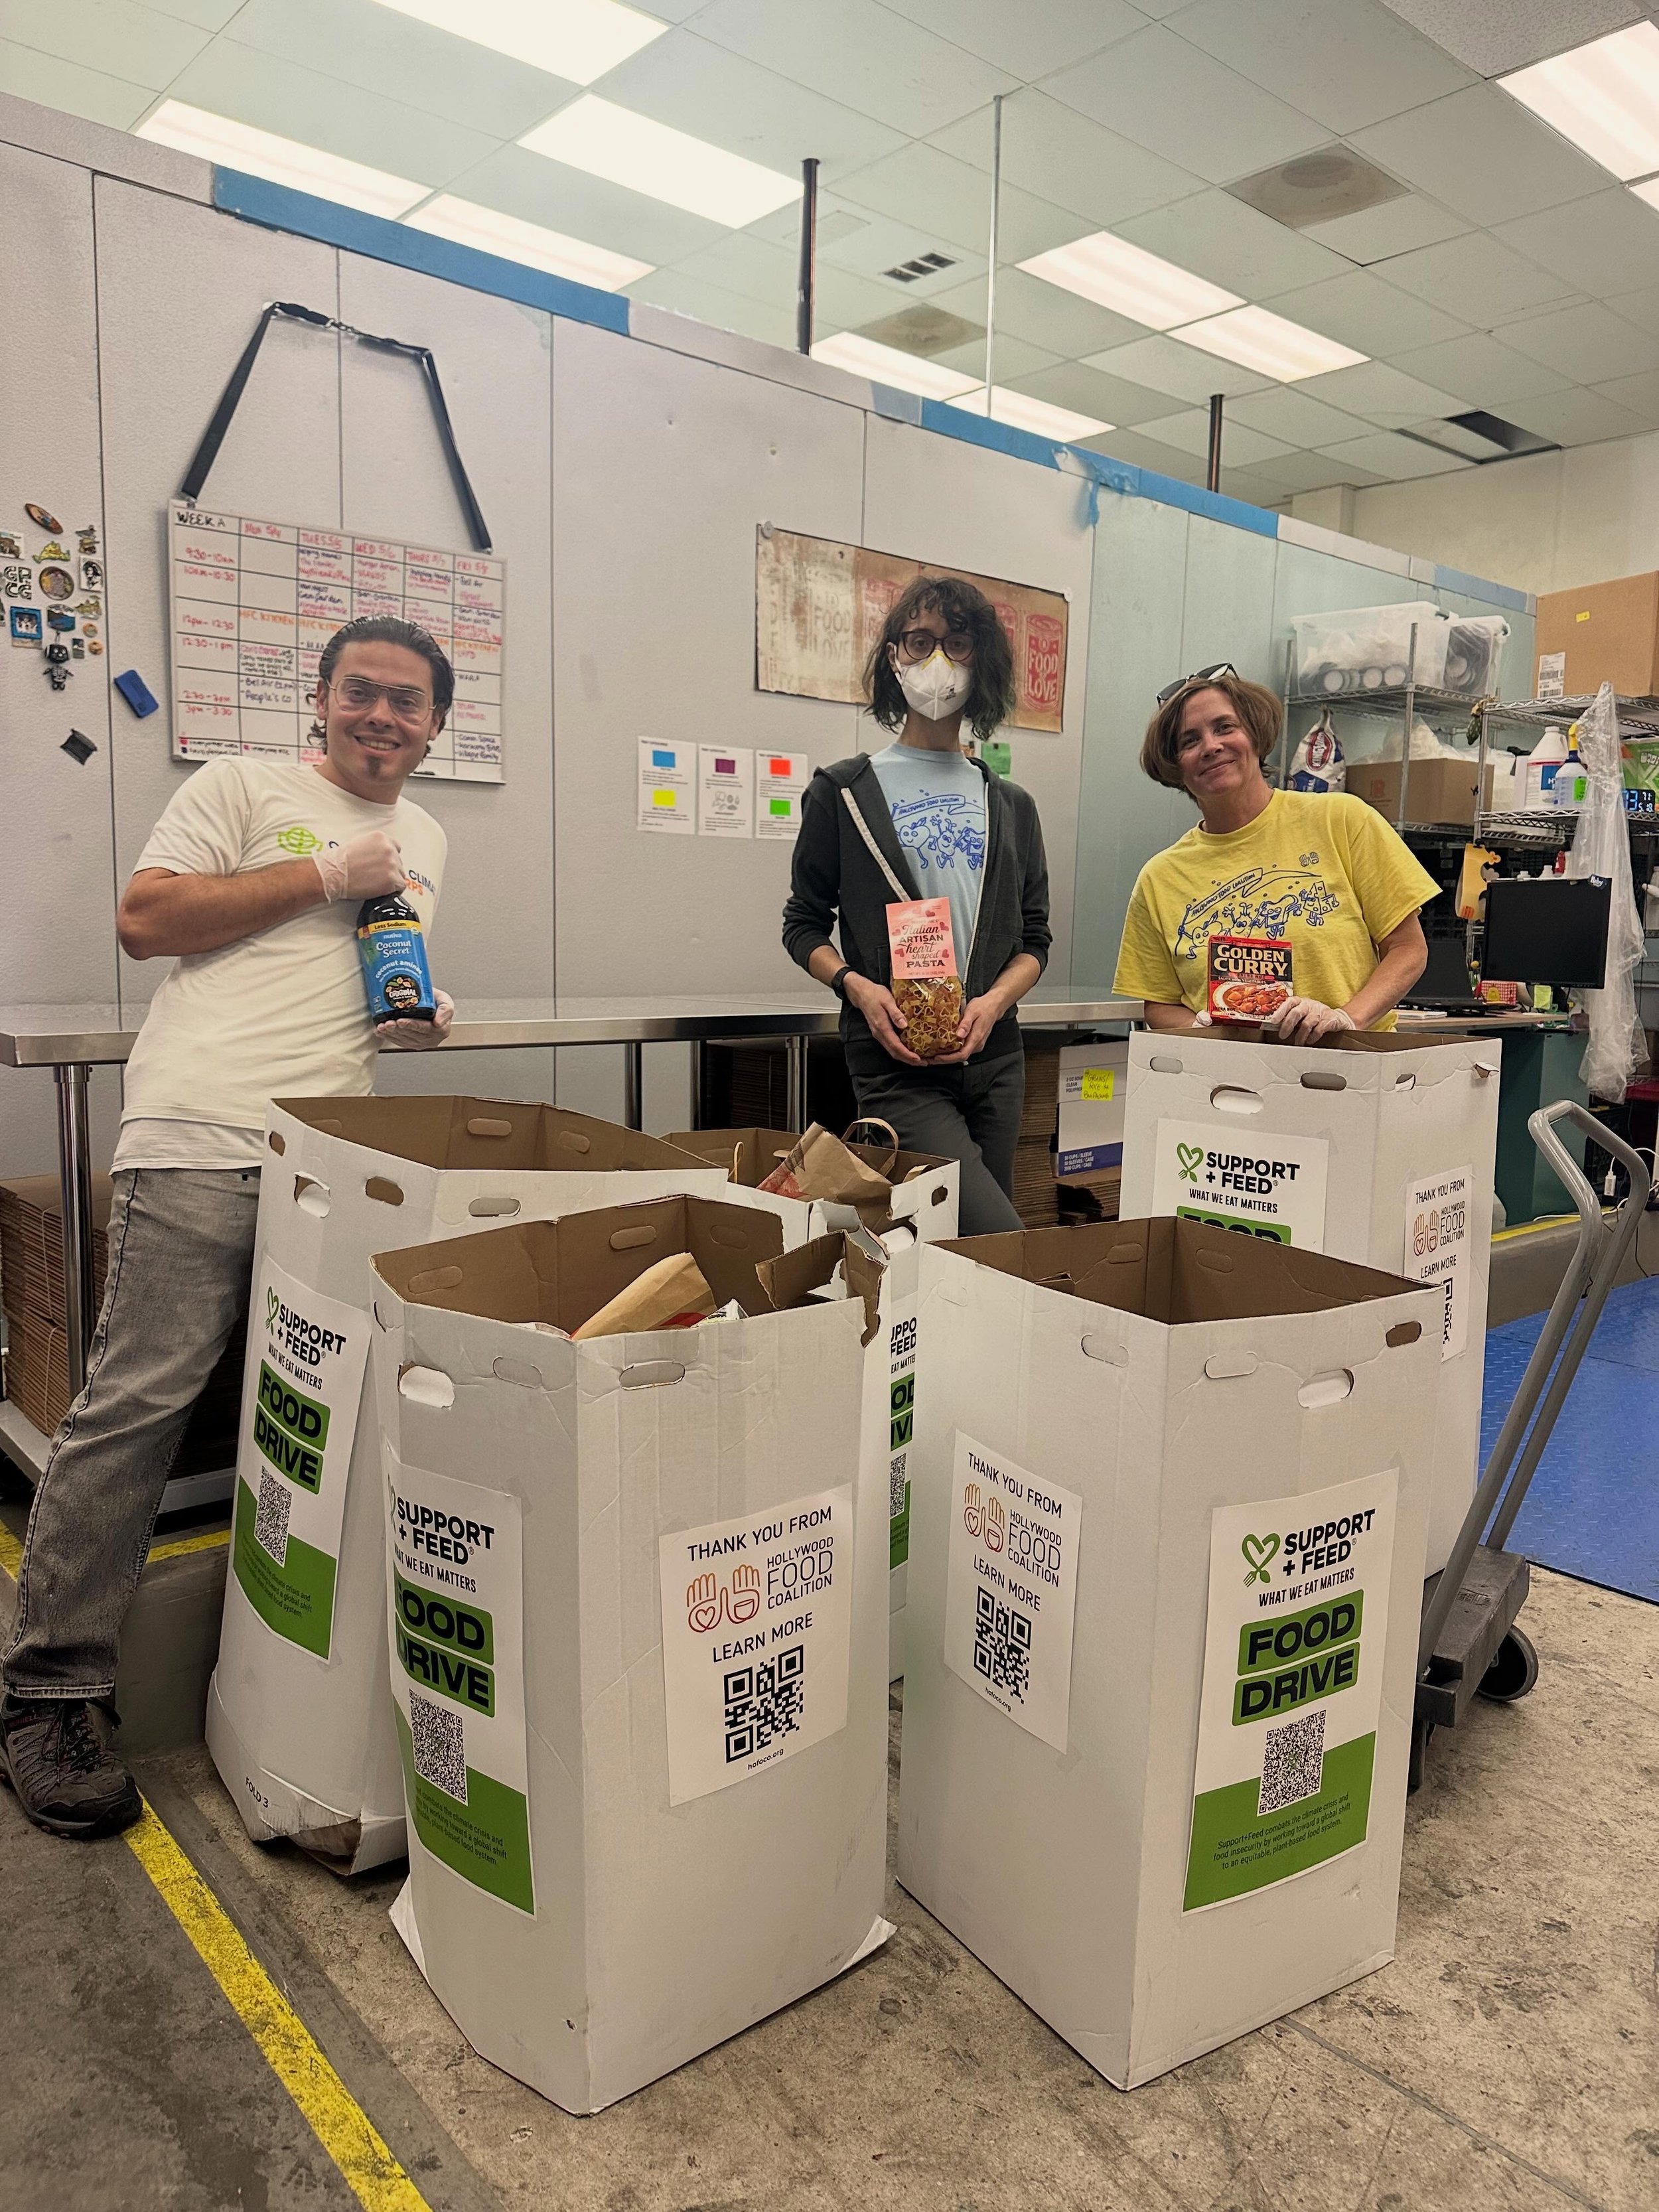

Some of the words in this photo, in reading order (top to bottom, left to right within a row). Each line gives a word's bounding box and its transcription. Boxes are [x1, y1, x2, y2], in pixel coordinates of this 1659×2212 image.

[177, 512, 215, 527] WEEK
[217, 518, 226, 528] A
[1029, 648, 1058, 674] FOOD
[1029, 674, 1057, 701] LOVE
[900, 934, 944, 943] ARTISAN
[902, 924, 940, 936] Italian
[376, 940, 412, 951] Coconut
[383, 947, 410, 958] Secret
[897, 942, 937, 954] heart
[912, 950, 941, 962] shaped
[1217, 944, 1285, 962] GOLDEN
[376, 960, 398, 979] coconut
[906, 960, 946, 968] PASTA
[1214, 957, 1289, 976] CURRY
[389, 988, 418, 998] ORIGINAL
[1206, 1151, 1300, 1180] SUPPORT
[1206, 1171, 1216, 1183] +
[1189, 1188, 1210, 1201] WHAT
[1212, 1193, 1223, 1204] WE
[1225, 1195, 1239, 1207] EAT
[1241, 1199, 1278, 1213] MATTERS
[1415, 1188, 1436, 1205] THANK
[1437, 1185, 1449, 1198] YOU
[1449, 1179, 1465, 1194] FROM
[1441, 1201, 1465, 1216] HOLLYWOOD
[1440, 1211, 1465, 1236] FOOD
[1440, 1230, 1465, 1247] COALITION
[1421, 1262, 1439, 1280] LEARN
[1441, 1254, 1457, 1272] MORE
[279, 1303, 346, 1355] SUPPORT
[278, 1351, 285, 1367] WE
[285, 1358, 294, 1374] EAT
[294, 1365, 323, 1390] MATTERS
[891, 1362, 900, 1374] EAT
[901, 1353, 916, 1369] MATTE
[261, 1370, 322, 1439] FOOD
[256, 1408, 319, 1487] DRIVE
[968, 1451, 999, 1485] THANK
[1002, 1473, 1023, 1498] YOU
[1027, 1488, 1062, 1519] FROM
[397, 1497, 494, 1550] SUPPORT
[687, 1532, 747, 1561] THANK
[752, 1521, 783, 1545] YOU
[789, 1505, 831, 1533] FROM
[1010, 1509, 1062, 1546] HOLLYWOOD
[1283, 1508, 1376, 1556] SUPPORT
[767, 1536, 833, 1569] HOLLYWOOD
[1009, 1522, 1061, 1571] FOOD
[405, 1554, 417, 1572] WE
[419, 1561, 435, 1578] EAT
[437, 1566, 476, 1593] MATTERS
[768, 1550, 833, 1595] FOOD
[1008, 1548, 1059, 1588] COALITION
[1283, 1559, 1295, 1577] +
[768, 1573, 832, 1609] COALITION
[974, 1554, 1005, 1589] LEARN
[1009, 1578, 1041, 1613] MORE
[1259, 1589, 1287, 1607] WHAT
[1289, 1584, 1303, 1601] WE
[1304, 1579, 1319, 1597] EAT
[1320, 1567, 1355, 1595] MATTERS
[301, 1592, 311, 1602] and
[713, 1631, 766, 1663] LEARN
[772, 1611, 813, 1643] MORE
[1247, 1602, 1356, 1666] FOOD
[1240, 1649, 1355, 1718] DRIVE
[985, 1686, 1012, 1712] hofoco.org
[747, 1748, 784, 1771] hofoco.org
[246, 1775, 262, 1803] FOLD
[263, 1797, 269, 1808] 3
[453, 1812, 473, 1831] climate
[474, 1825, 490, 1840] crisis
[491, 1835, 503, 1847] and
[1212, 1851, 1229, 1862] food
[1230, 1841, 1262, 1858] insecurity
[1263, 1838, 1272, 1849] by
[1272, 1828, 1295, 1844] working
[1296, 1820, 1316, 1834] toward
[1321, 1808, 1338, 1826] global
[1338, 1801, 1351, 1816] shift
[1217, 1828, 1265, 1850] Support+Feed
[1265, 1819, 1291, 1836] combats
[1291, 1814, 1301, 1826] the
[1301, 1805, 1323, 1822] climate
[1323, 1798, 1338, 1812] crisis
[1338, 1791, 1349, 1805] and
[461, 1838, 474, 1853] food
[473, 1836, 491, 1851] global
[493, 1846, 507, 1860] shift
[1222, 1860, 1230, 1871] to
[1230, 1858, 1240, 1868] an
[1240, 1848, 1272, 1865] equitable,
[1272, 1833, 1307, 1856] plant-based
[1307, 1826, 1321, 1840] food
